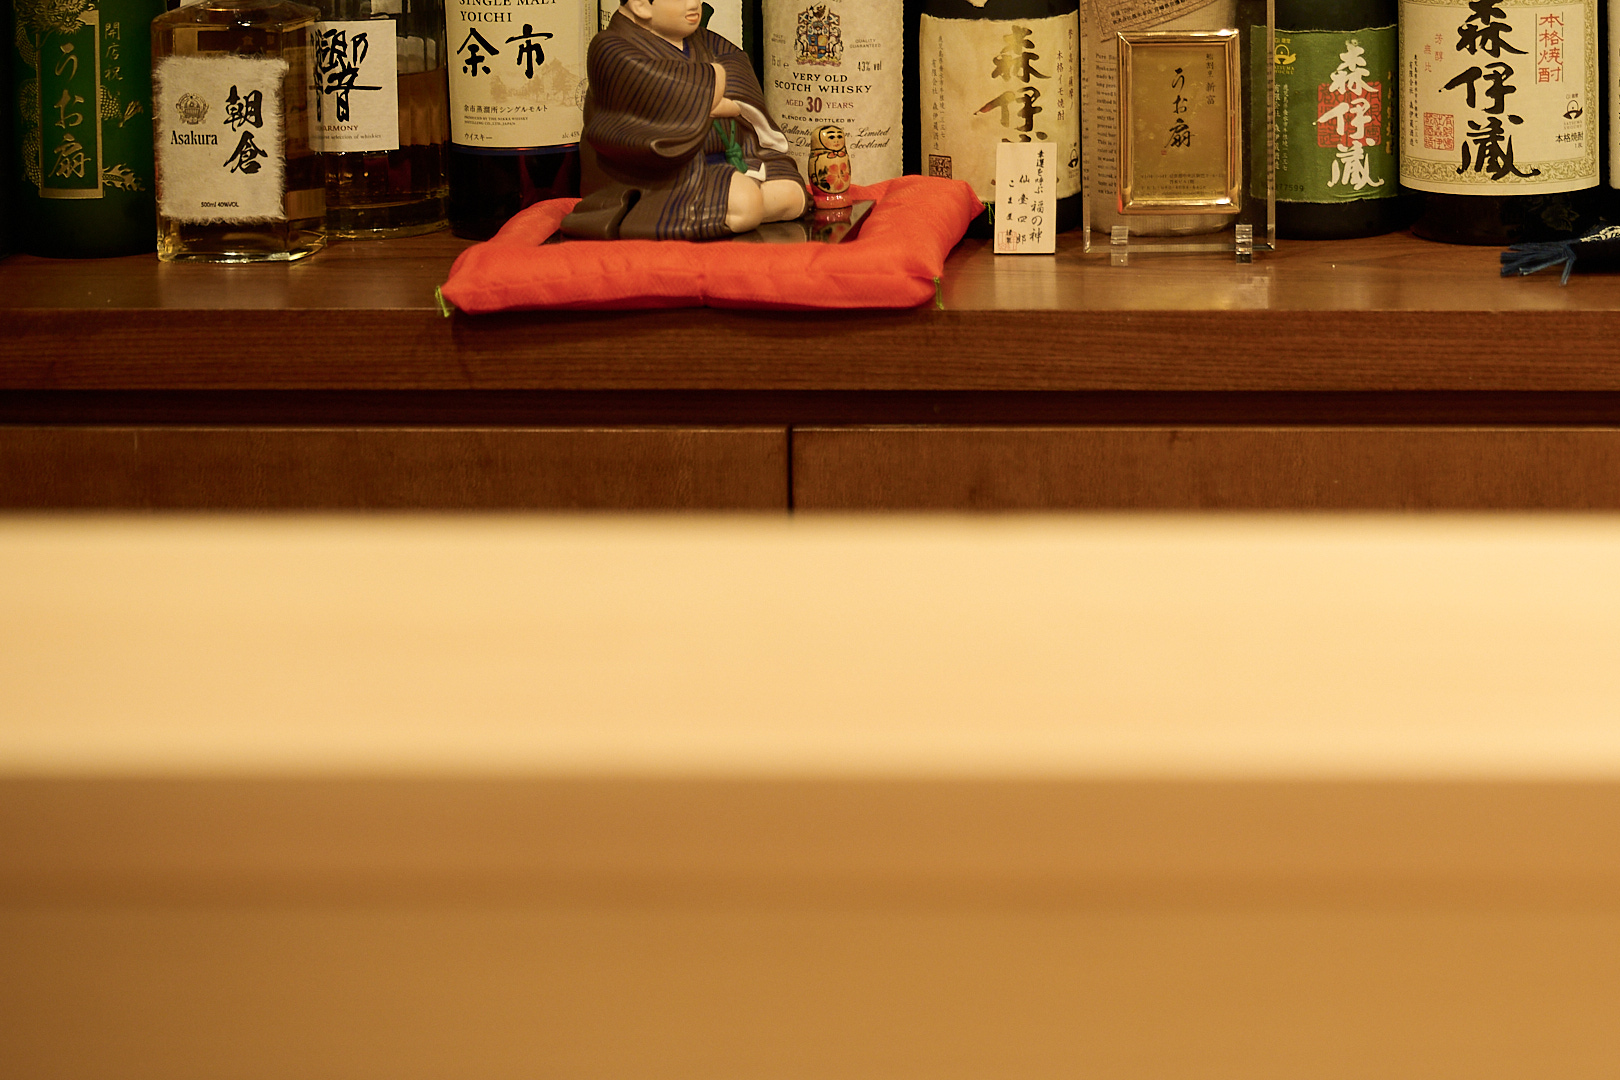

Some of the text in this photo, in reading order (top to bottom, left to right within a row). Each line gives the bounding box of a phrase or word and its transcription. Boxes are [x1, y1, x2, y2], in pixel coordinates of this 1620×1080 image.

[460, 10, 513, 24] YOICHI
[457, 23, 554, 79] 余市
[1537, 13, 1564, 84] 本格焼酎
[857, 60, 882, 72] 43% vol
[313, 27, 383, 123] 響
[793, 72, 848, 83] VERY OLD
[973, 24, 1052, 143] 森伊
[774, 80, 873, 94] SCOTCH WHISKY
[786, 96, 854, 113] AGED 30 YEARS
[1164, 67, 1195, 149] うお扇
[782, 114, 808, 122] BLENDED
[1312, 38, 1385, 191] 森伊蔵
[170, 130, 218, 145] Asakura
[223, 85, 268, 175] 朝倉
[463, 132, 493, 141] ウイスキー
